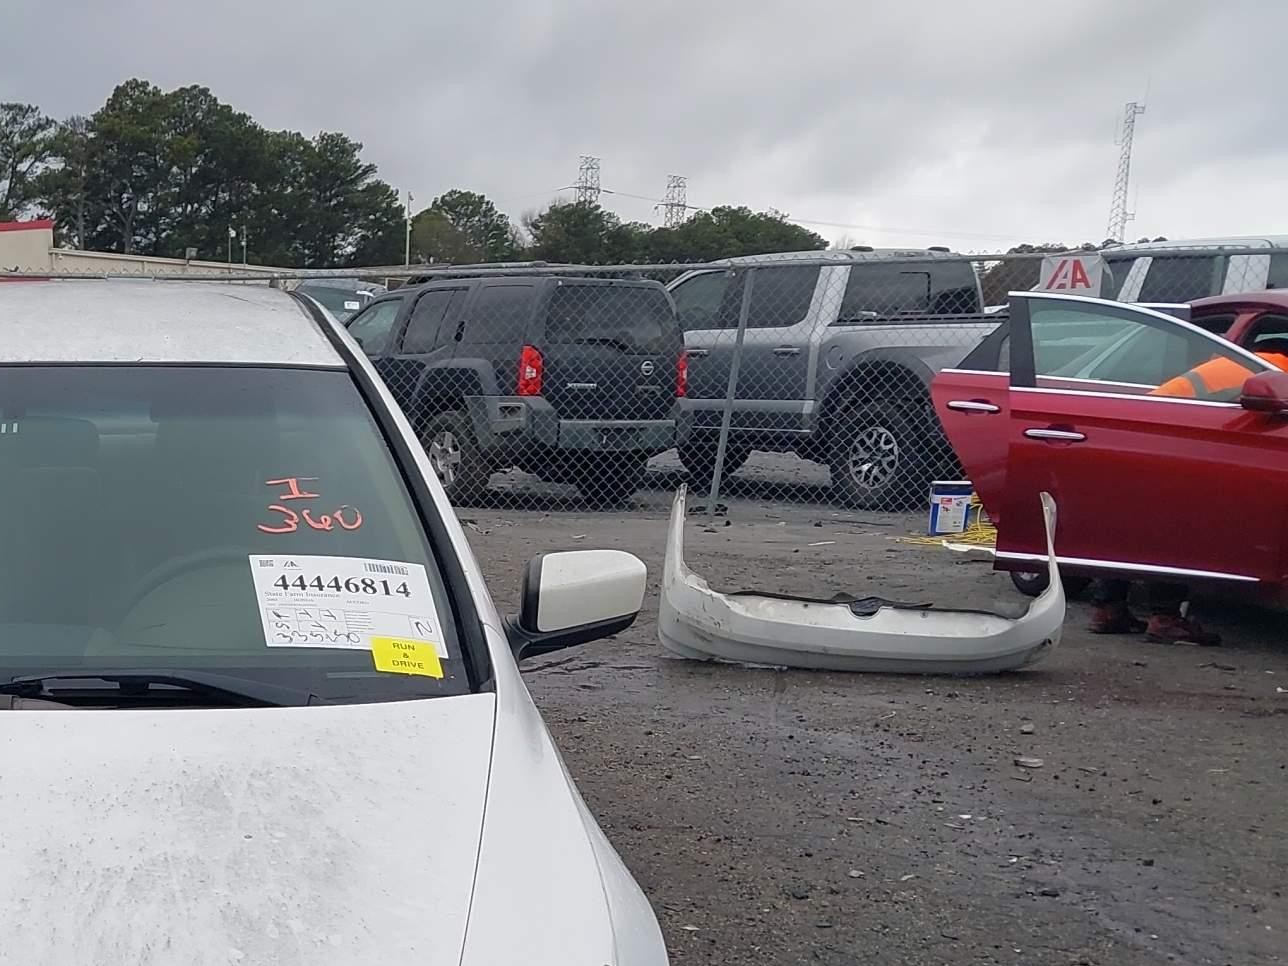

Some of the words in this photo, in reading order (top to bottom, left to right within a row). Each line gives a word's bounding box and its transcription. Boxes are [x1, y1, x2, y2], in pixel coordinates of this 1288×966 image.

[257, 504, 363, 533] 360
[274, 574, 411, 597] 44446814
[392, 642, 416, 651] RUN
[392, 659, 425, 670] DRIVE
